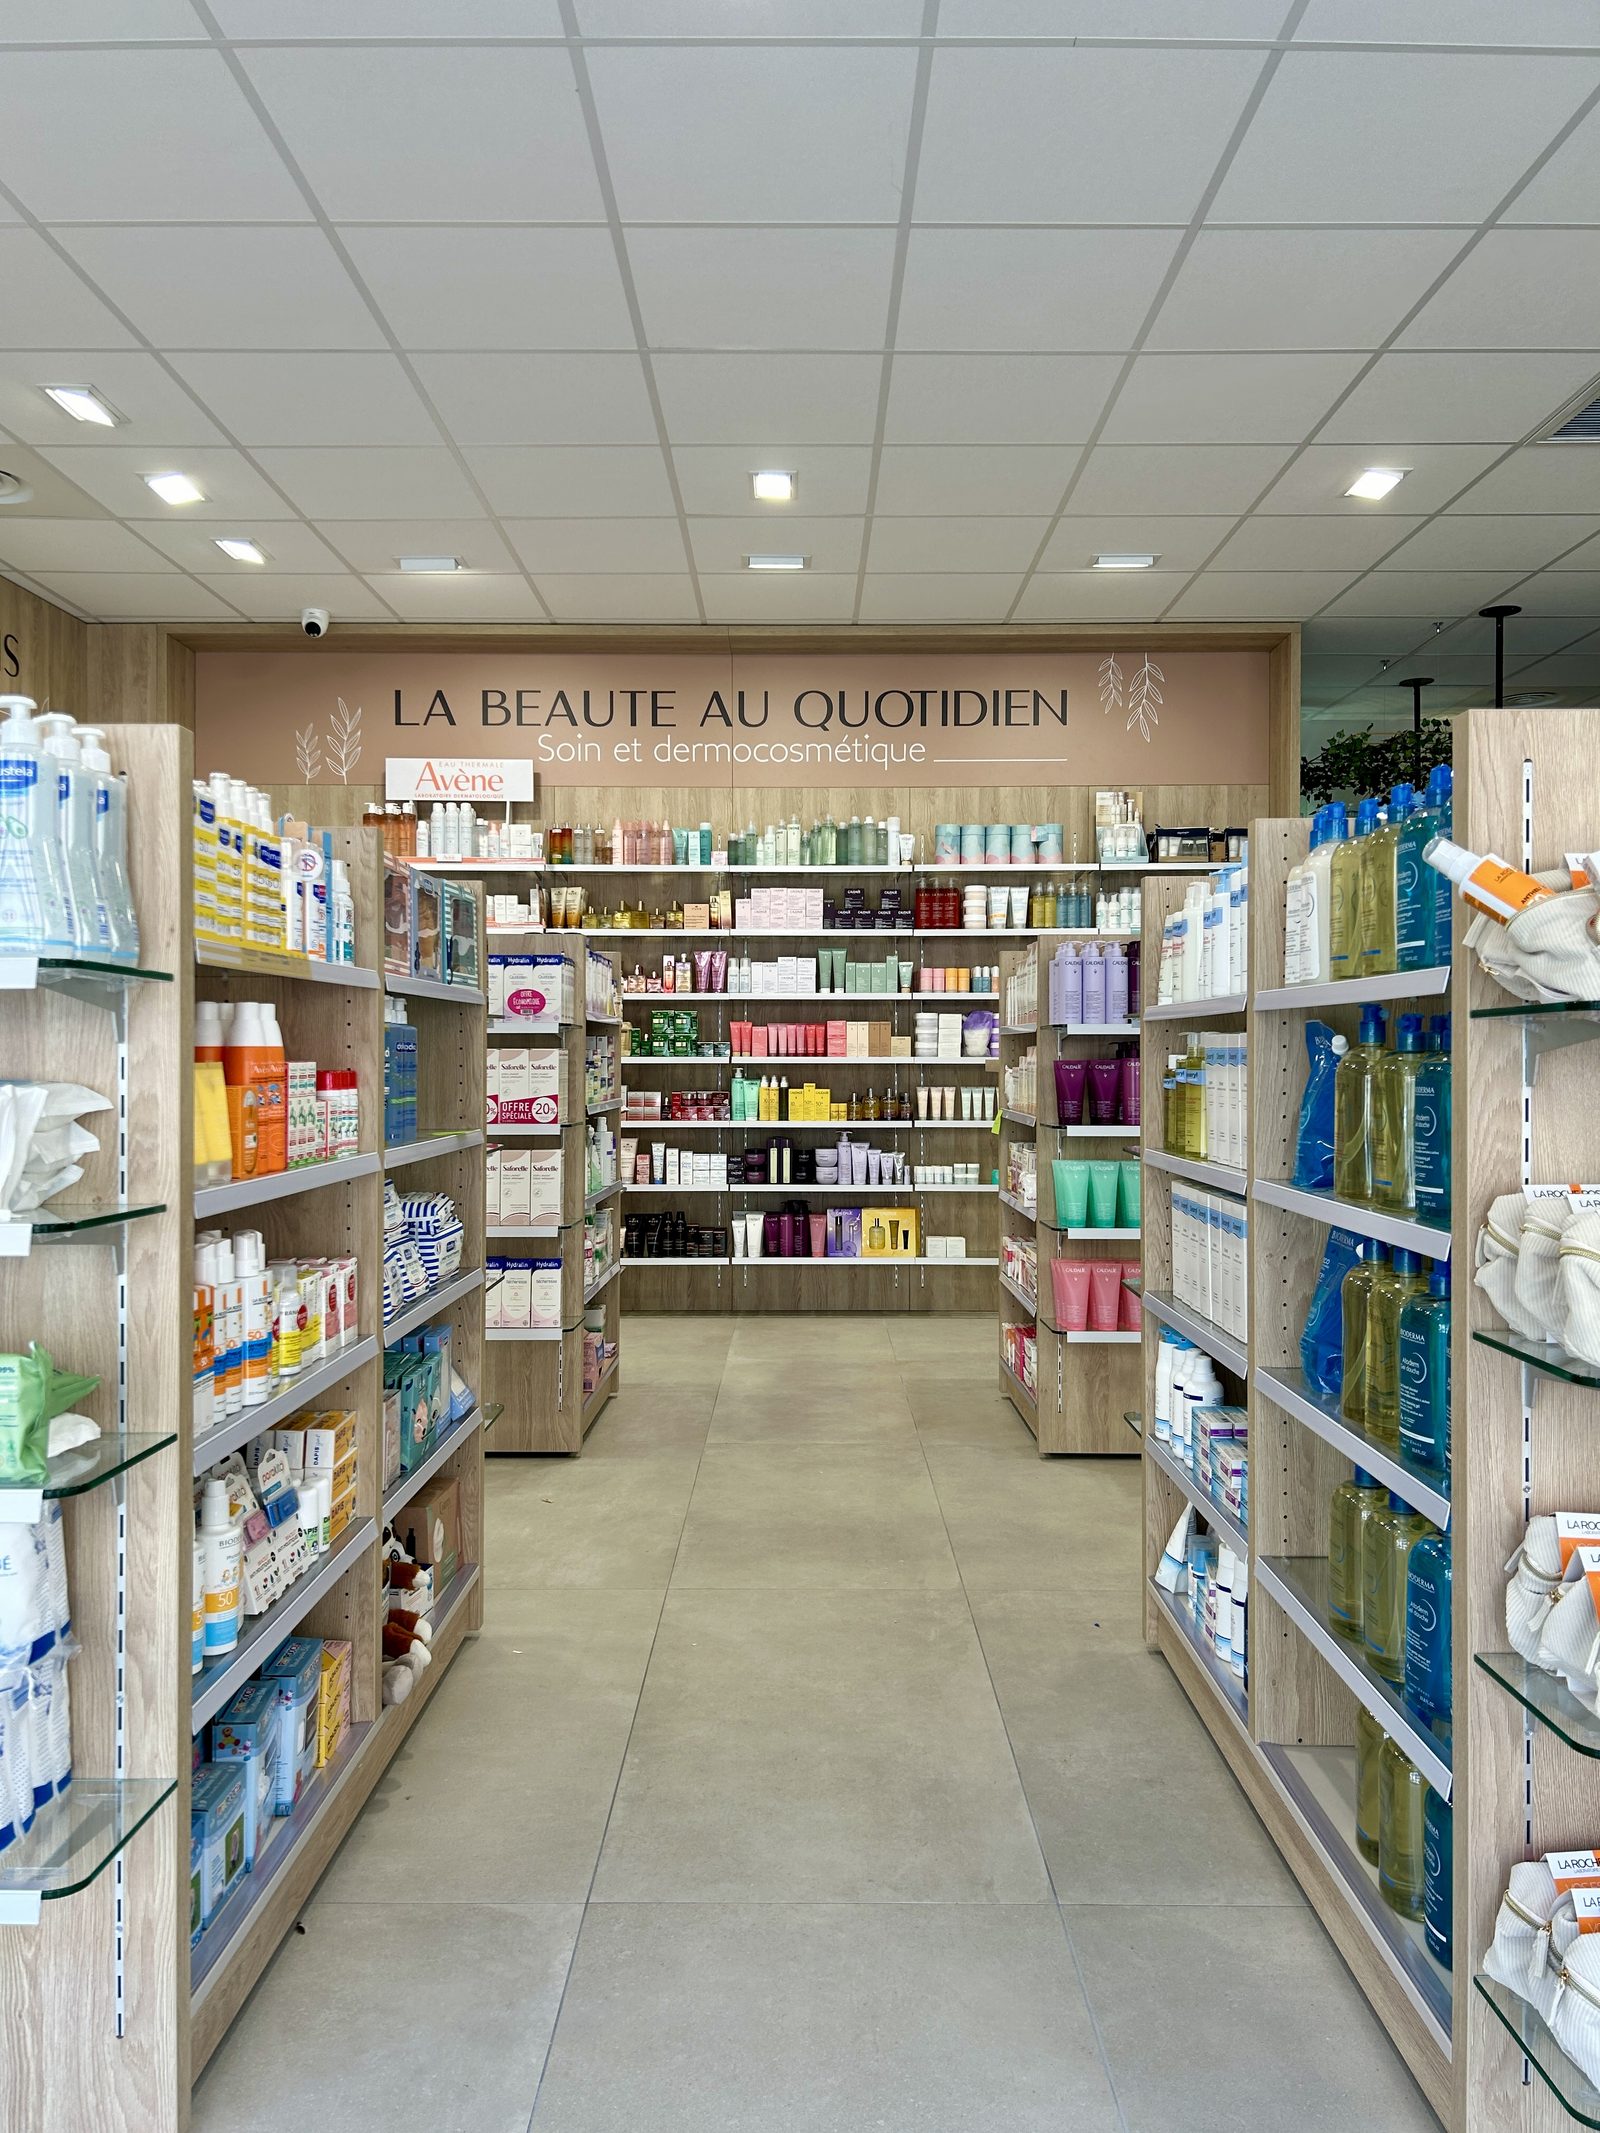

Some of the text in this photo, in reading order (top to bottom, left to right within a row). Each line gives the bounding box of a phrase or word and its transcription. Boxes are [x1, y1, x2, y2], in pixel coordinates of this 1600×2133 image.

[394, 689, 1068, 731] LA BEAUTE AU QUOTIDIEN
[538, 733, 926, 771] Soin et dermocosmétique
[438, 761, 504, 769] EAU THERMALE
[415, 761, 504, 792] Avène
[507, 957, 530, 965] Hydralin
[536, 957, 559, 965] Hydralin
[502, 1102, 530, 1112] OFFRE
[501, 1110, 532, 1120] SPÉCIALE
[506, 1261, 529, 1269] Hydralin
[1566, 1519, 1580, 1529] LA
[1558, 1859, 1572, 1870] LA
